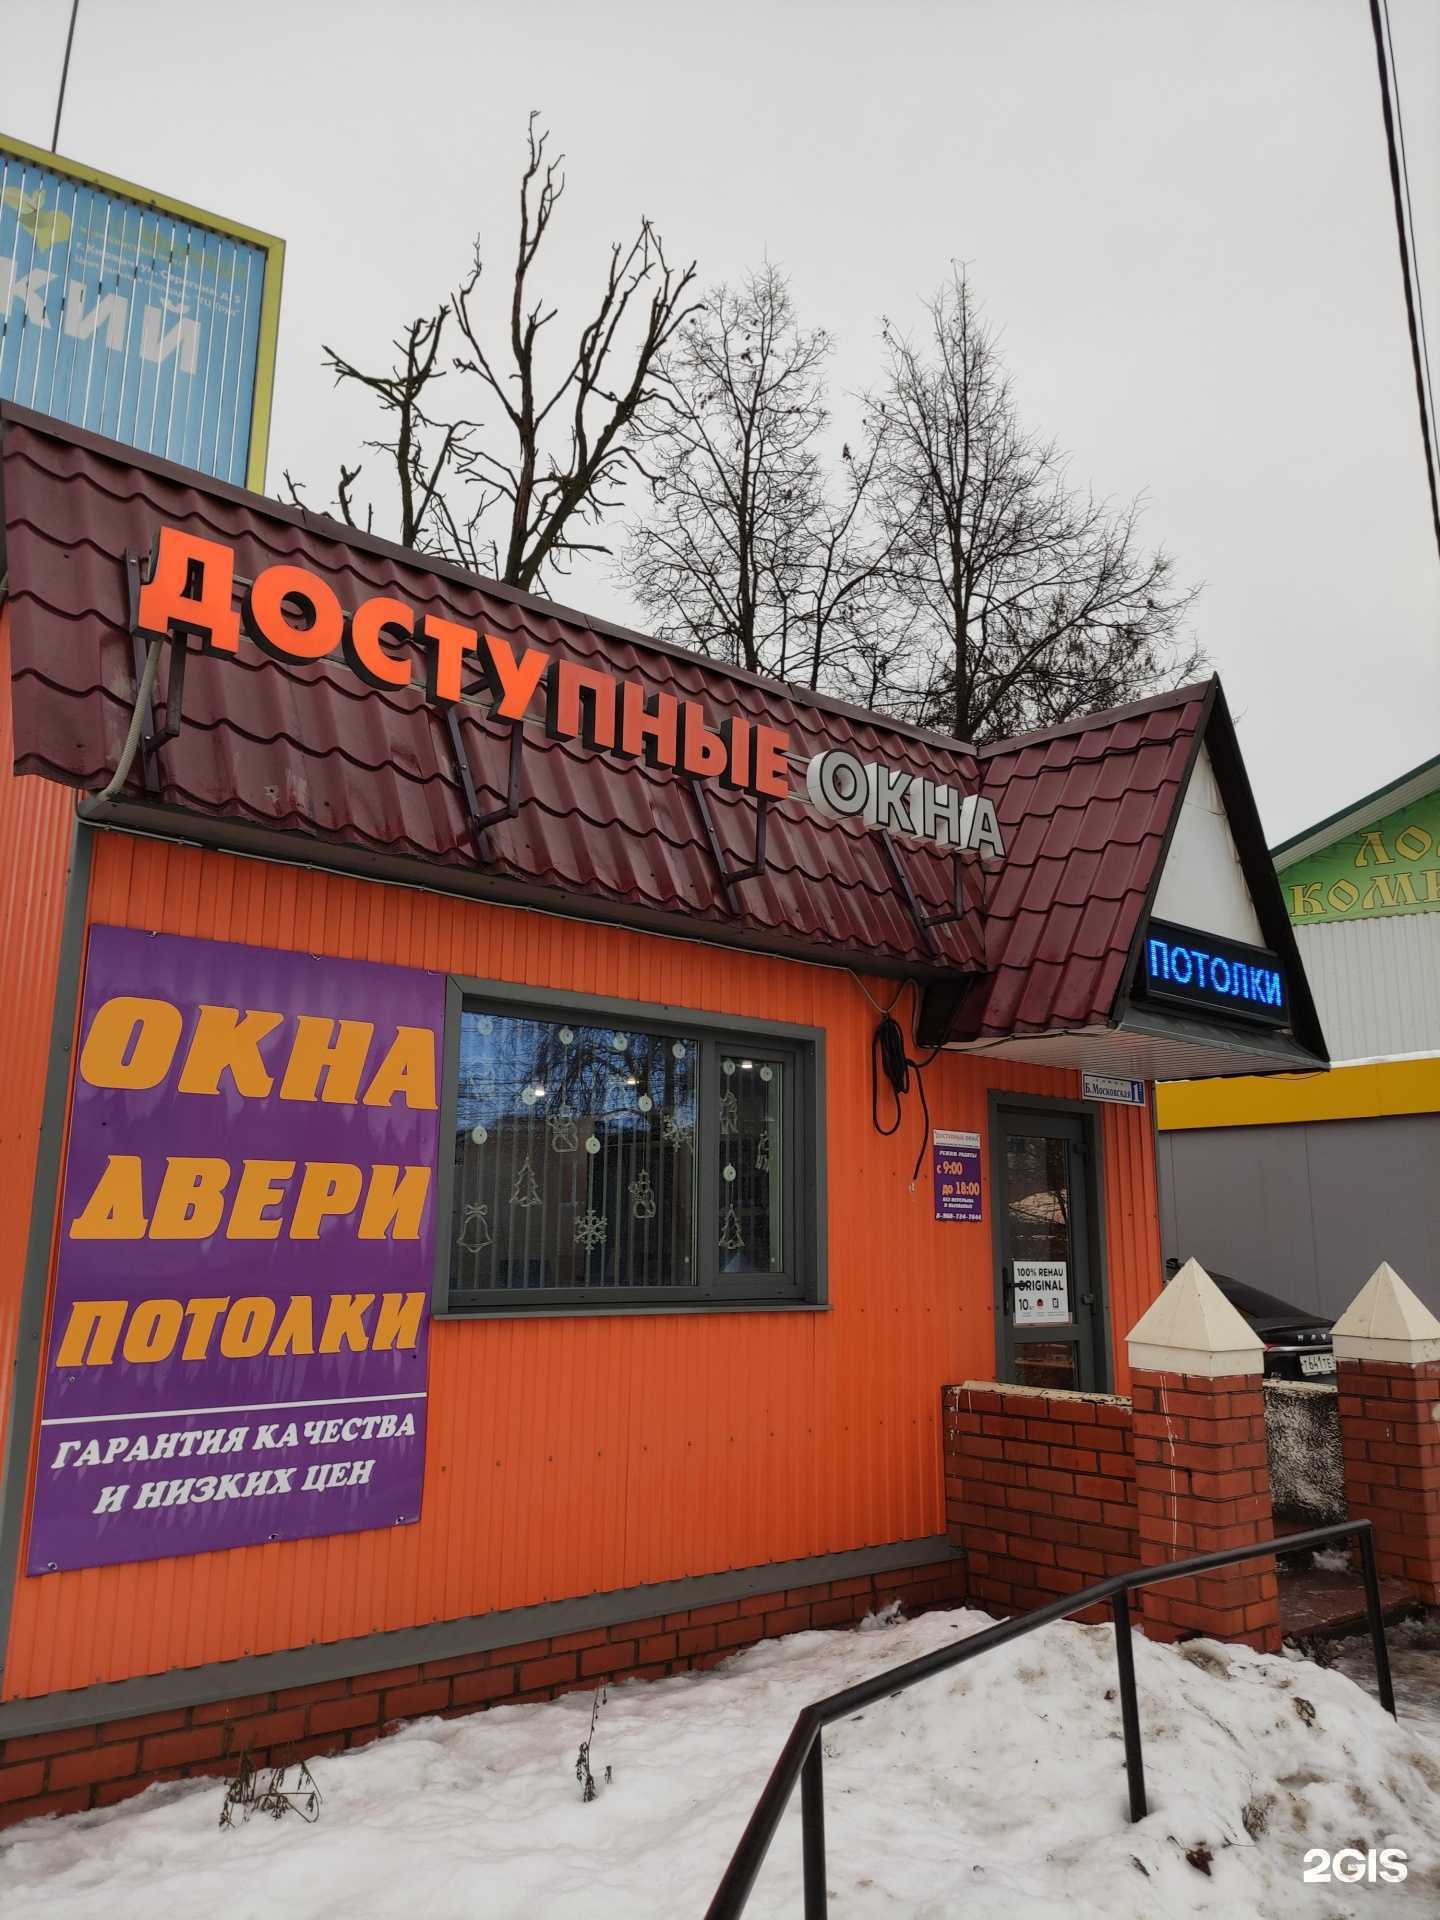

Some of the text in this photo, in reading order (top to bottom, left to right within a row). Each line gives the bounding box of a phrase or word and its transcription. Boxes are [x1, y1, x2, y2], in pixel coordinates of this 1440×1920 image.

[137, 526, 1007, 859] ДОСТУПНЫЕ ОКНА
[1354, 825, 1440, 868] ЛО
[1148, 938, 1283, 1007] ПОТОЛКИ
[79, 995, 439, 1111] ОКНА
[942, 1161, 963, 1176] 9:00
[955, 1181, 980, 1196] 18:00
[68, 1153, 432, 1241] ДВЕРИ
[1017, 1267, 1064, 1277] 100% REHAU
[1018, 1280, 1064, 1292] ORIGINAL
[55, 1291, 427, 1368] ПОТОЛКИ
[1018, 1298, 1029, 1311] 10
[51, 1412, 416, 1470] ГАРАНТИЯ КАЧЕСТВА
[92, 1459, 377, 1515] И НИЗКИХ ЦЕН
